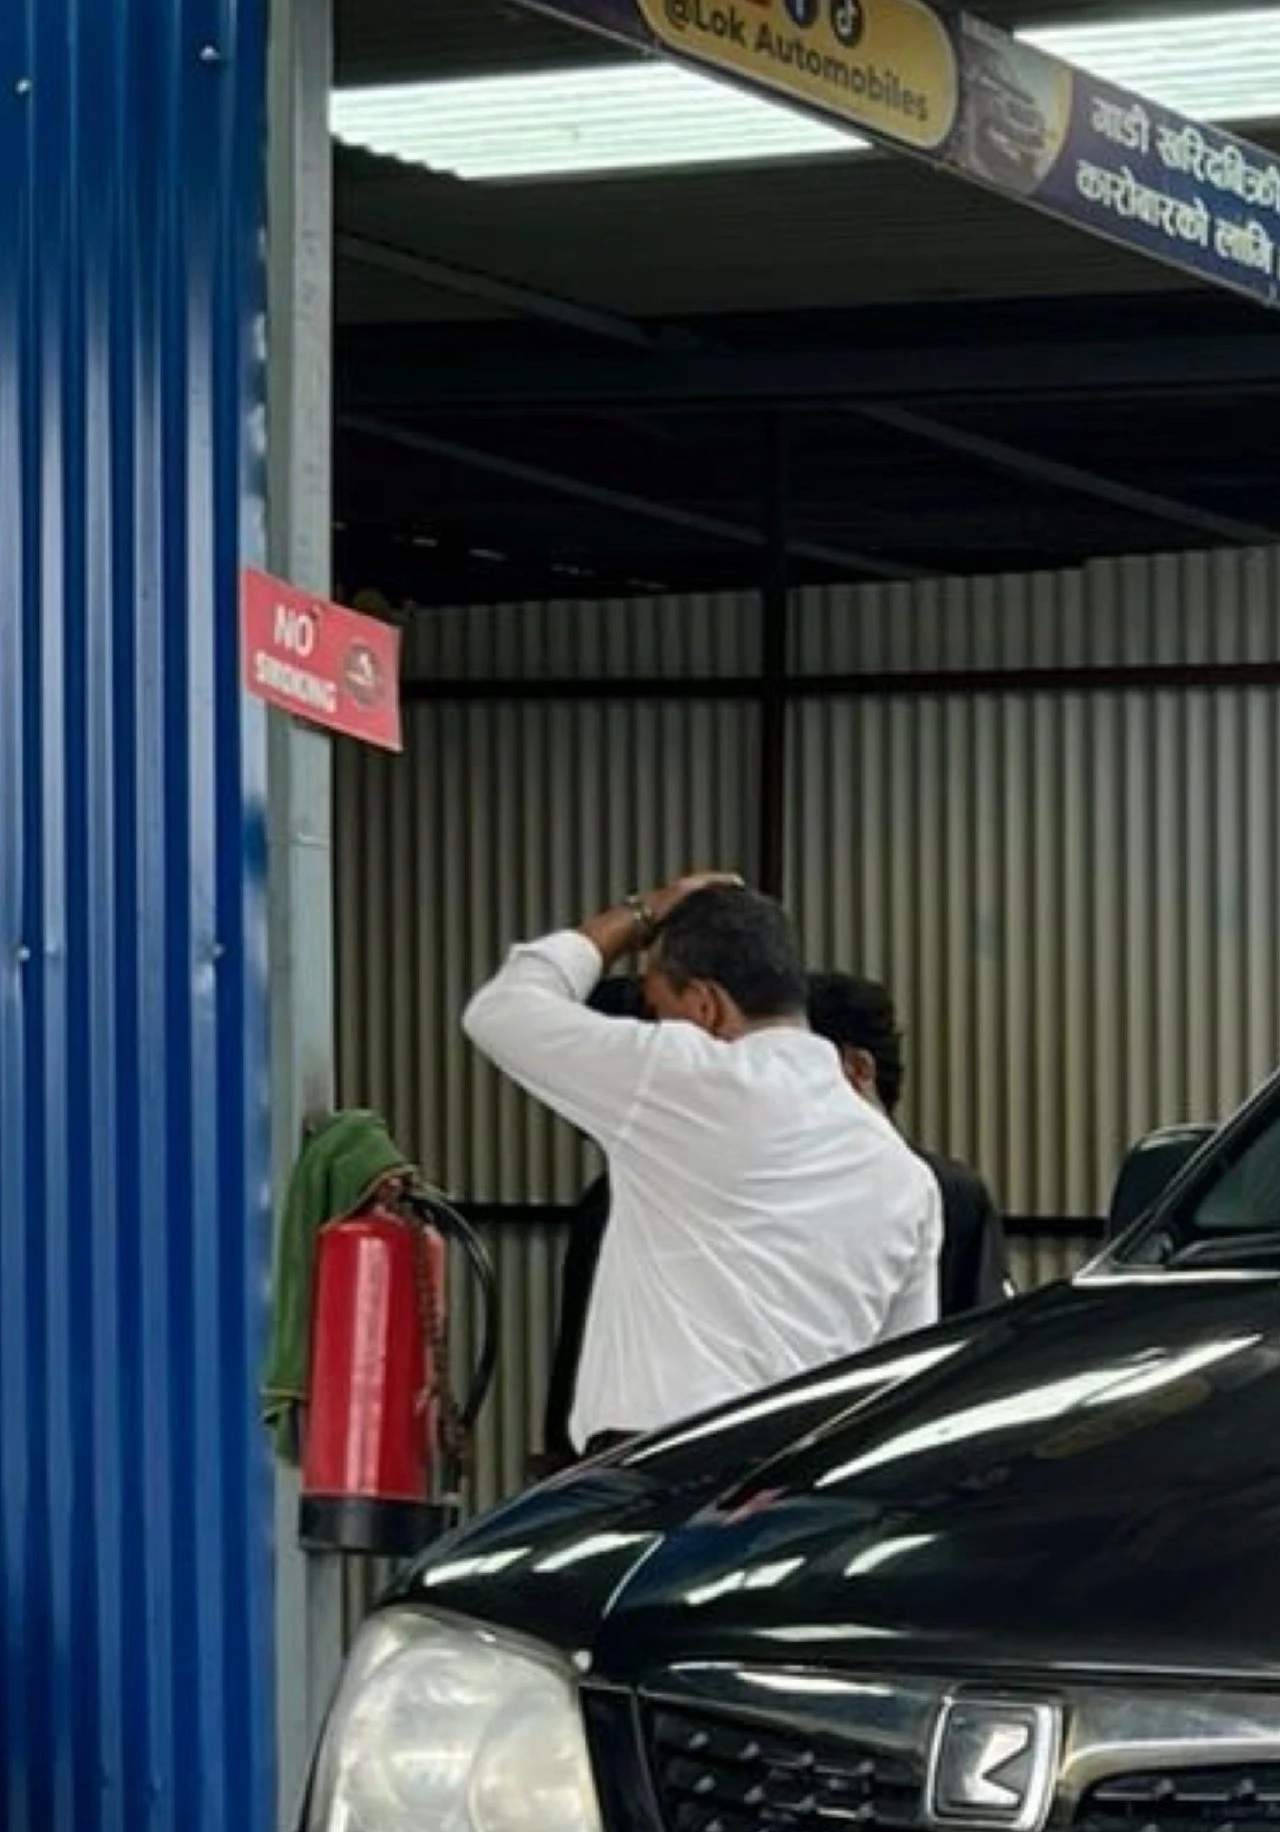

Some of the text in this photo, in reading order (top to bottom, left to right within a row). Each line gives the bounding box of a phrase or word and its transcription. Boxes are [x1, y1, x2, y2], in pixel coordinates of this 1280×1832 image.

[754, 23, 928, 122] Automobiles
[1092, 98, 1149, 154] गाडी
[274, 604, 313, 657] NO
